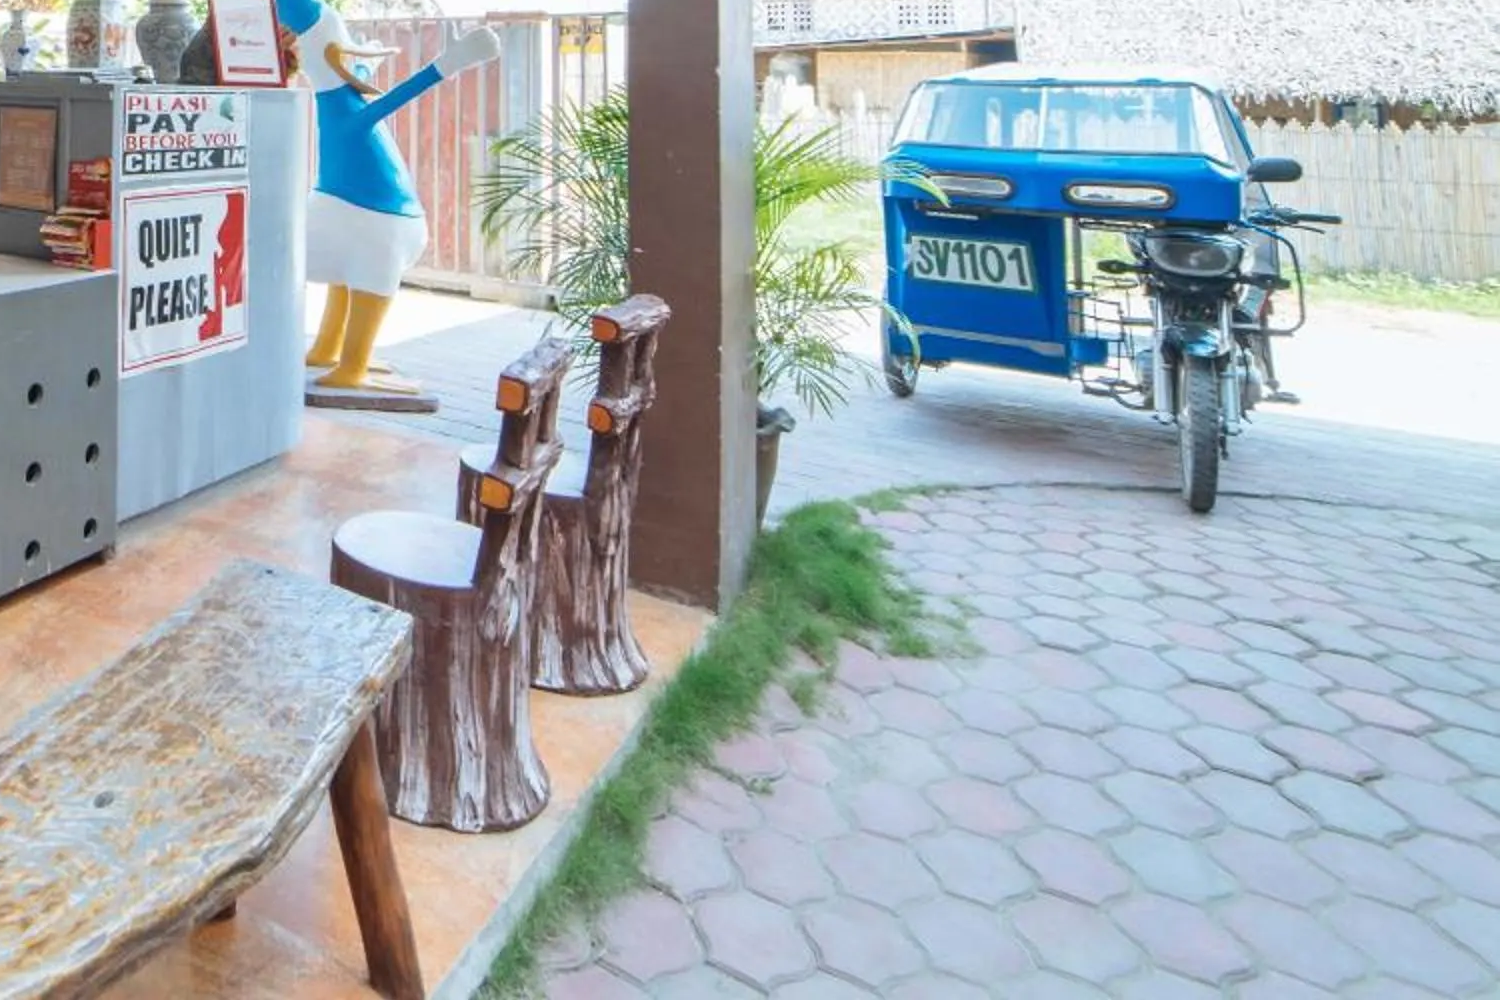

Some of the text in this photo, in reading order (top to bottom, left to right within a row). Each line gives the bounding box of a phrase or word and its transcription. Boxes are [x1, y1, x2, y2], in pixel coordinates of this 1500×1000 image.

[127, 113, 200, 133] PAY
[125, 132, 237, 151] BEFORE YOU
[125, 149, 215, 172] CHECK
[223, 149, 246, 166] IN
[138, 213, 203, 268] QUIET
[915, 239, 1028, 286] SV1101
[129, 273, 209, 330] PLEASE
